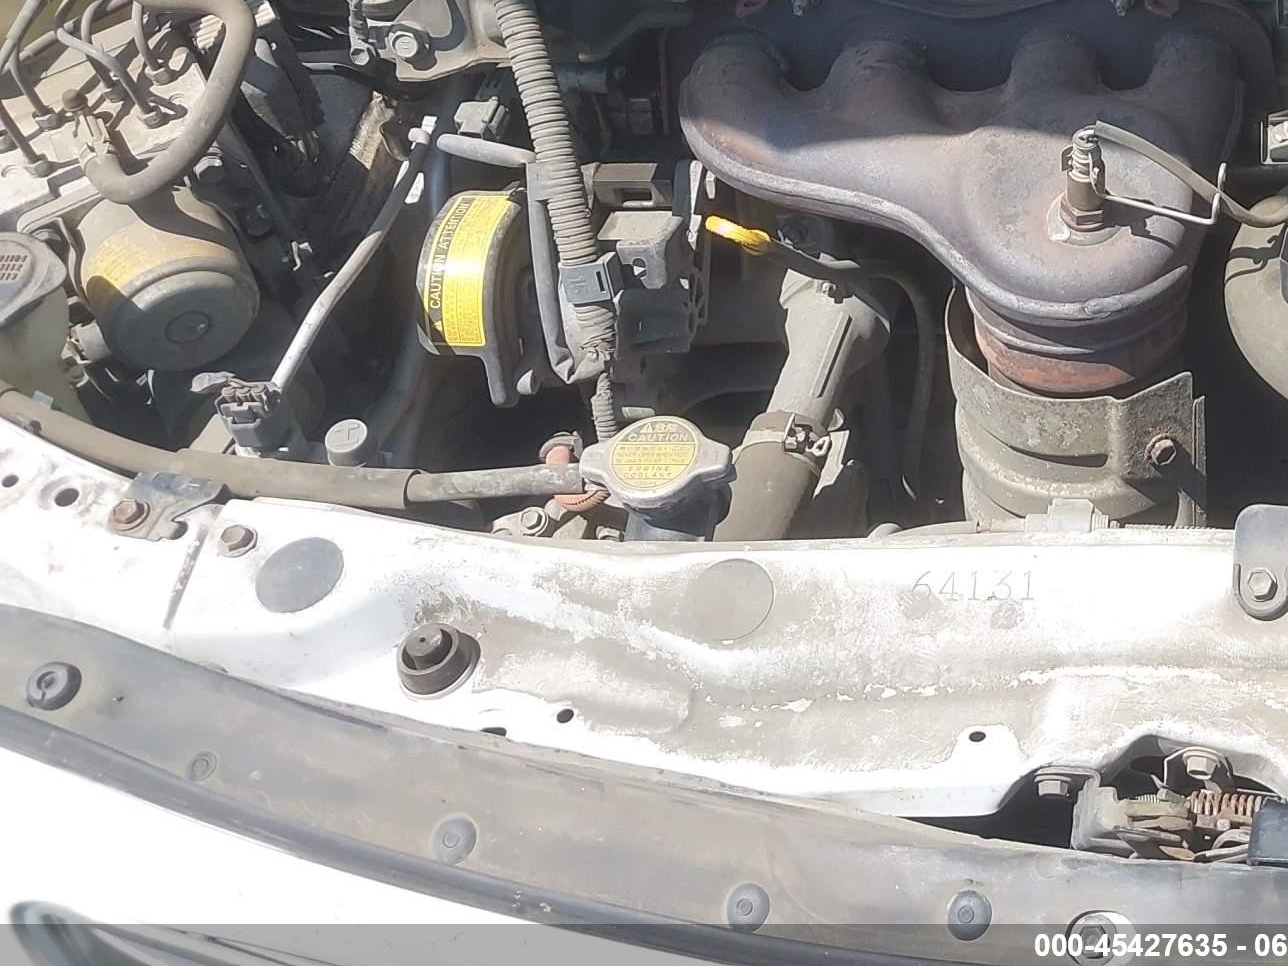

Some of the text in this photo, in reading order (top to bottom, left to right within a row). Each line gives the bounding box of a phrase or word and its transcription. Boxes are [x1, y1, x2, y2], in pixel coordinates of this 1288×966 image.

[430, 202, 470, 309] CAUTION ATTENTION
[628, 433, 689, 442] CAUTION
[912, 570, 1035, 601] 64131
